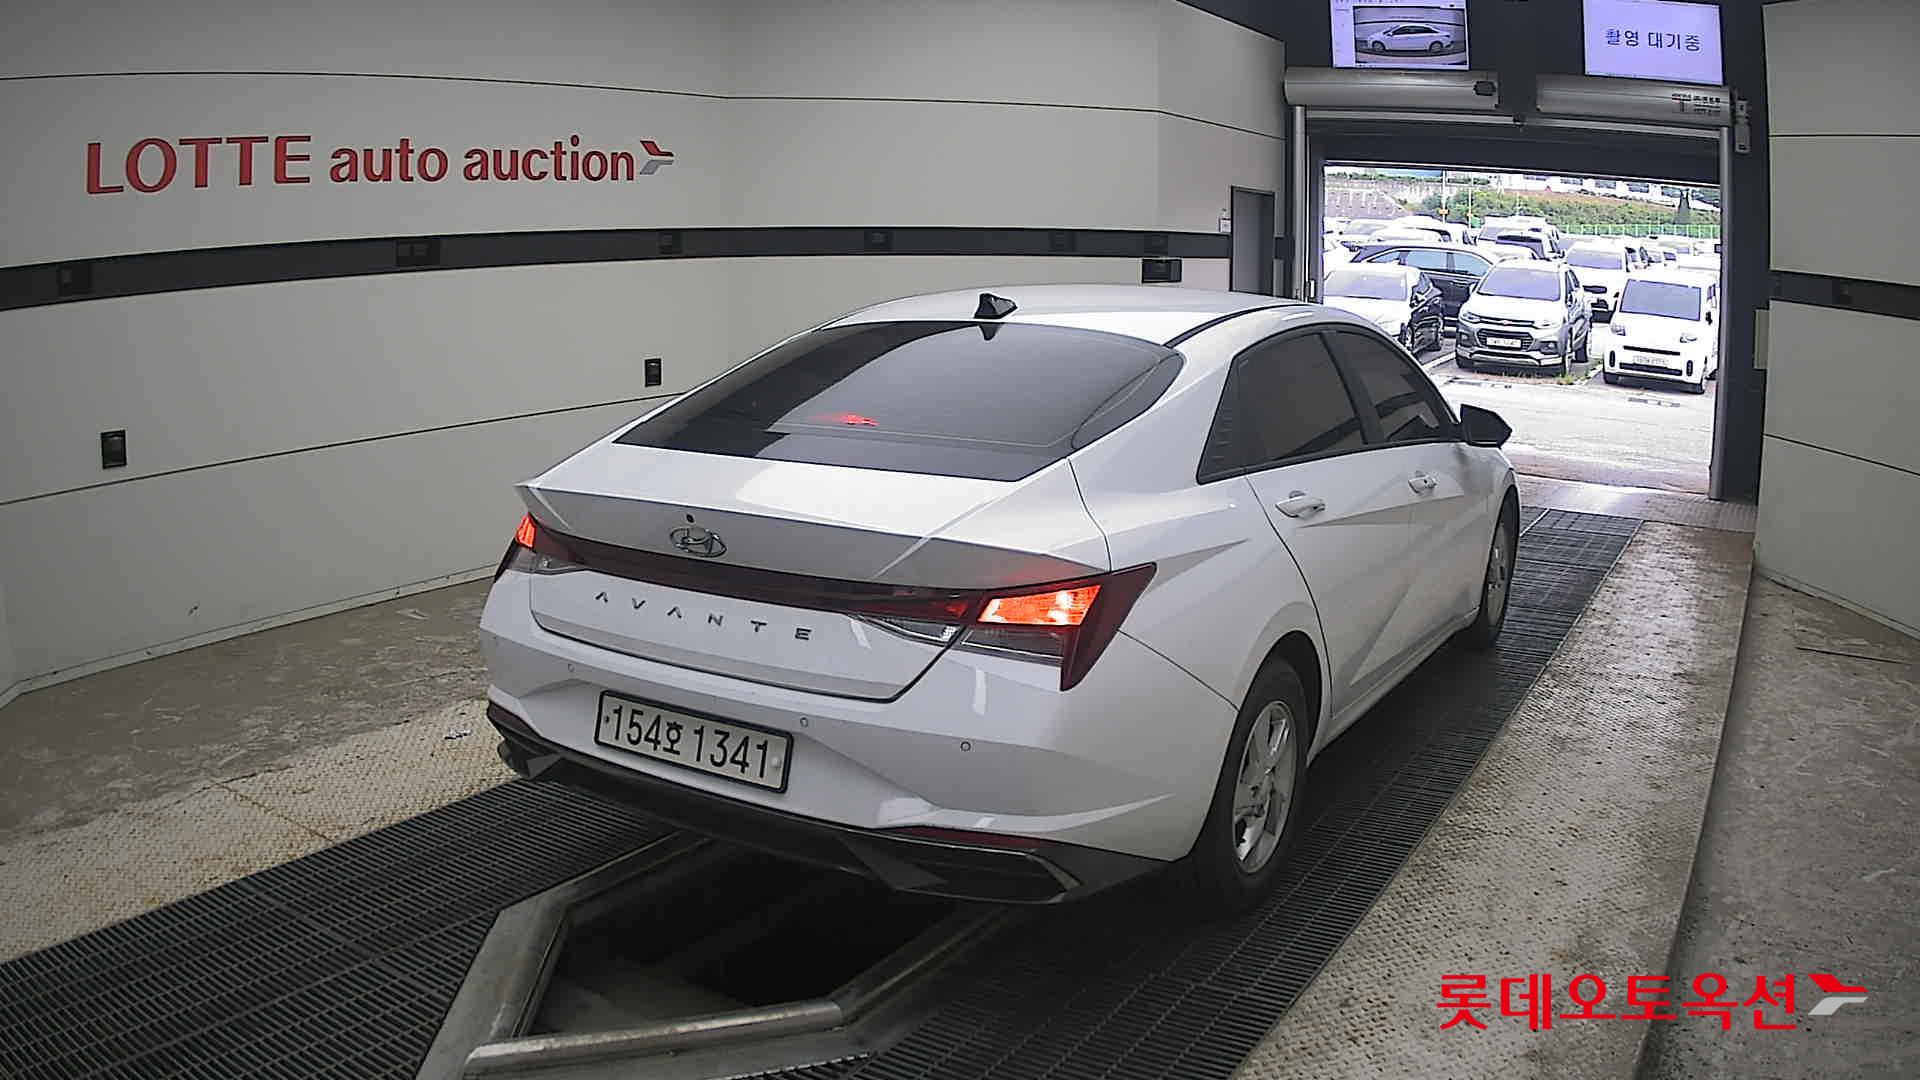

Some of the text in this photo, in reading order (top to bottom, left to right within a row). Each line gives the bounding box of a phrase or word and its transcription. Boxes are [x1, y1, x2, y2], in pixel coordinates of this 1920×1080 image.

[1647, 32, 1701, 52] 대기중
[86, 134, 635, 195] LOTTE auto auction
[594, 591, 813, 641] AVANTE
[612, 704, 769, 779] 154호 1341
